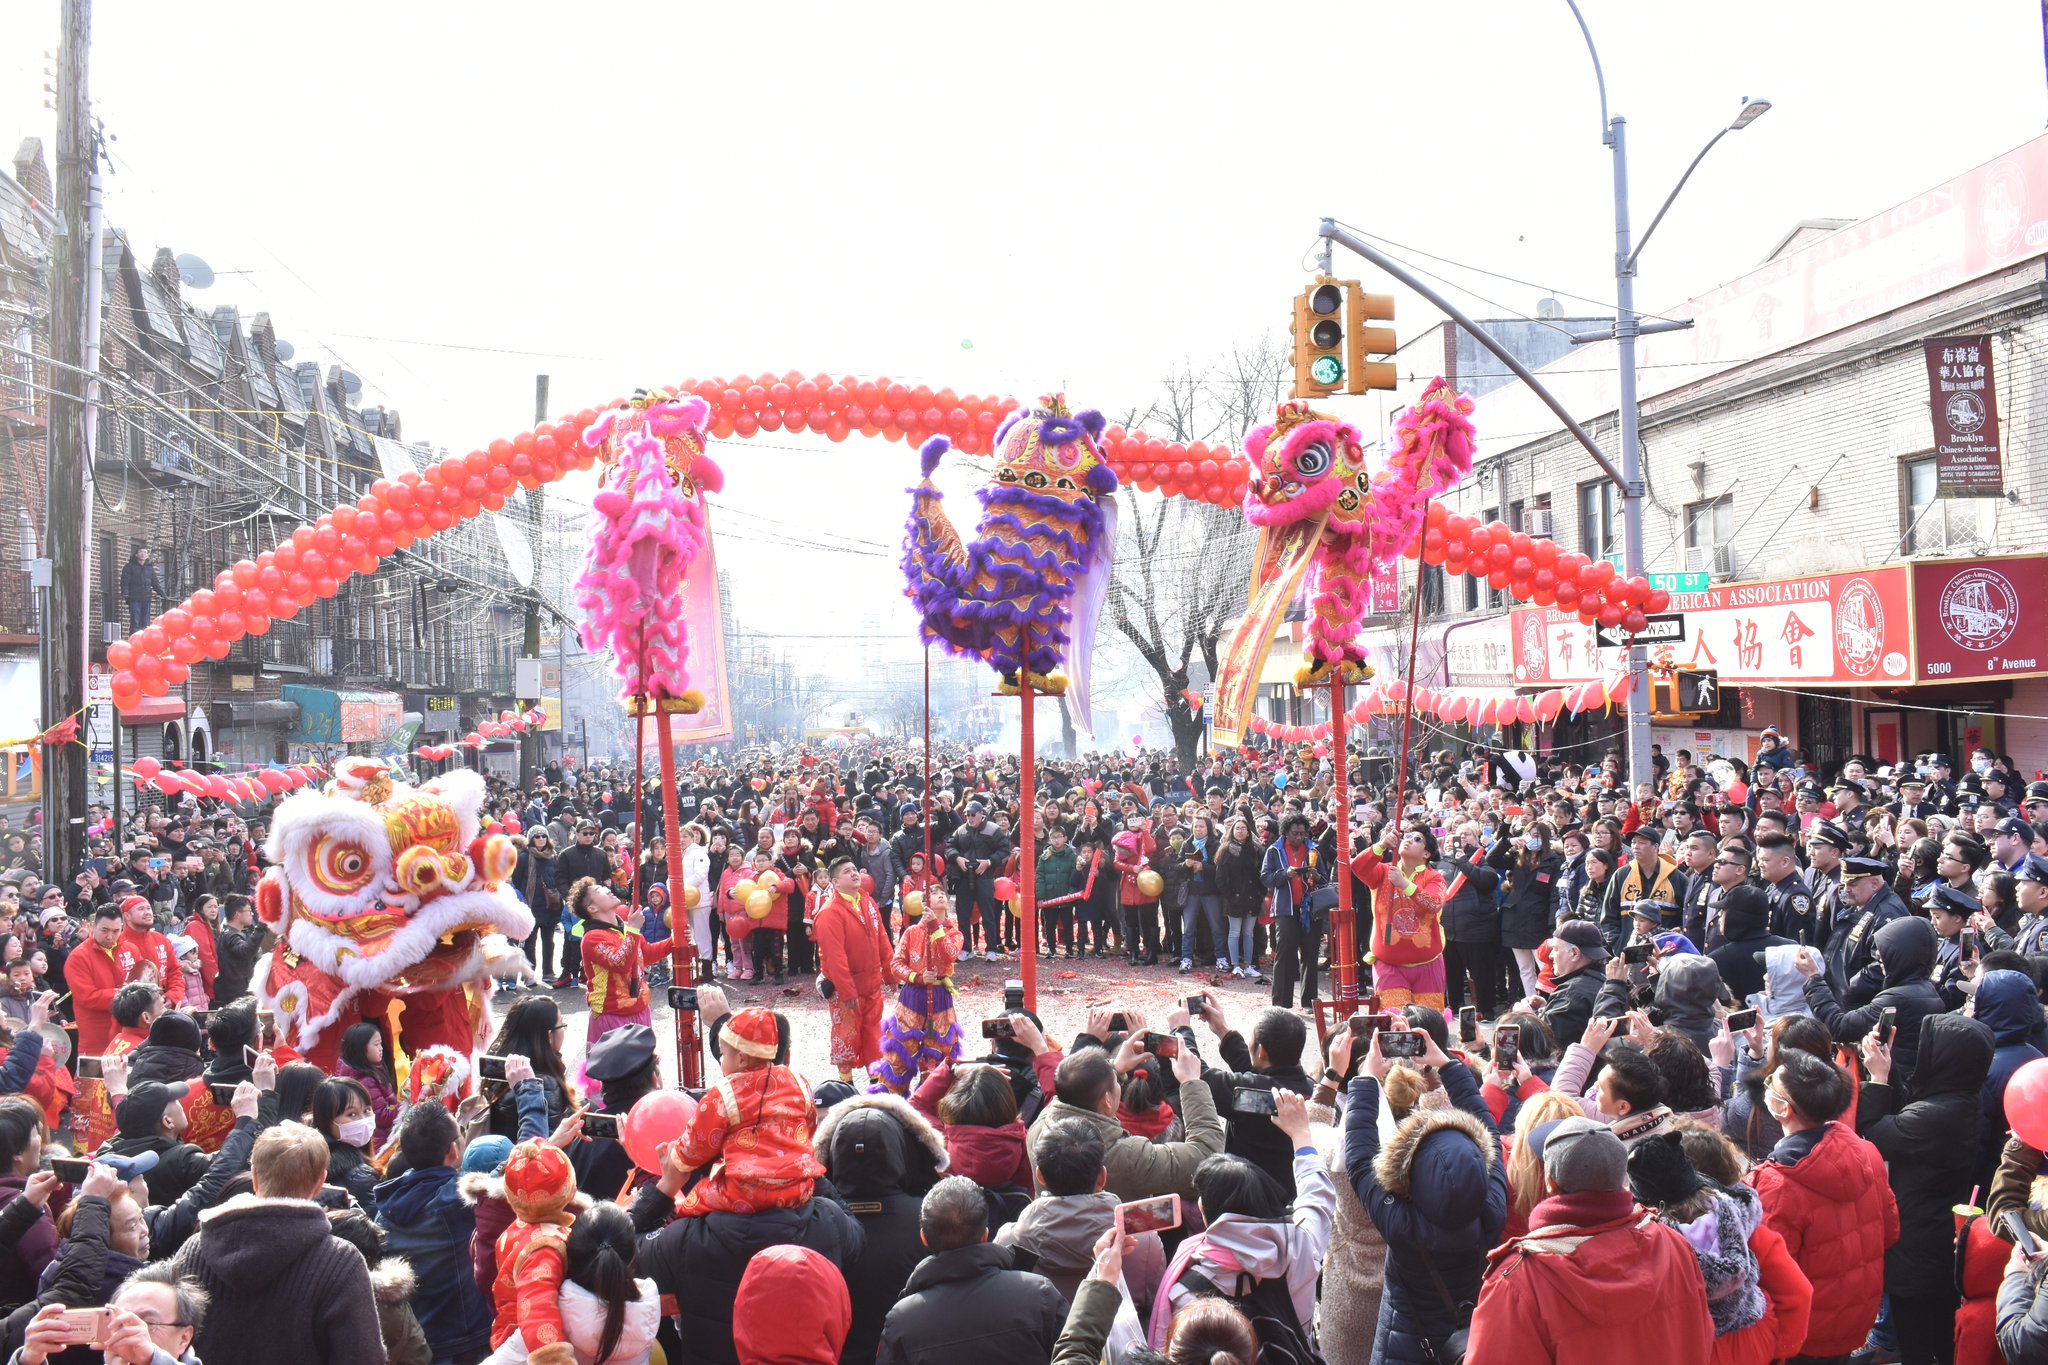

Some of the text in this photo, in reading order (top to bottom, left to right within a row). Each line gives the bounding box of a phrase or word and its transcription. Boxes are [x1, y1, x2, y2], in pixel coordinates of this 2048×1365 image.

[1951, 433, 1984, 444] Brooklyn
[1939, 444, 1997, 454] Chinese-American
[1951, 454, 1987, 463] Association
[1655, 573, 1700, 591] 50 ST
[1729, 579, 1831, 607] ASSOCIATION
[1646, 623, 1674, 636] WAY
[1927, 662, 1952, 675] 5000
[2002, 658, 2037, 670] Avenue
